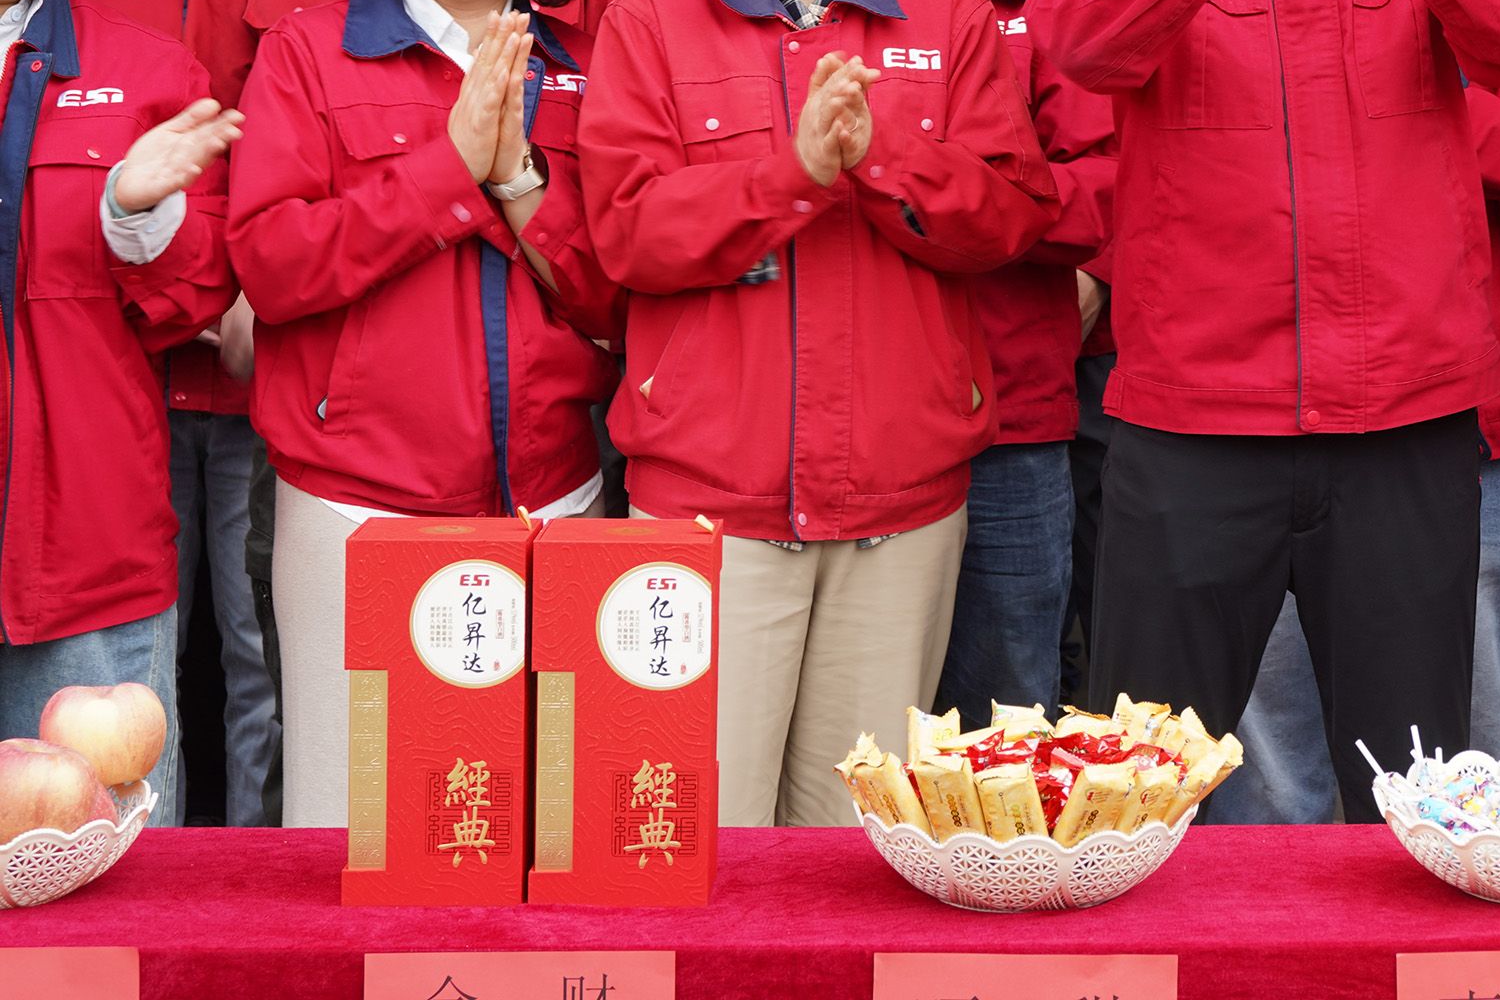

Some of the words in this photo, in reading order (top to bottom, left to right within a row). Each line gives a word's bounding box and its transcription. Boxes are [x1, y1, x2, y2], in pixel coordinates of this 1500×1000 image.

[462, 592, 487, 673] 亿昇达
[649, 595, 674, 676] 亿昇达
[437, 757, 496, 868] 經典
[623, 759, 682, 869] 經典
